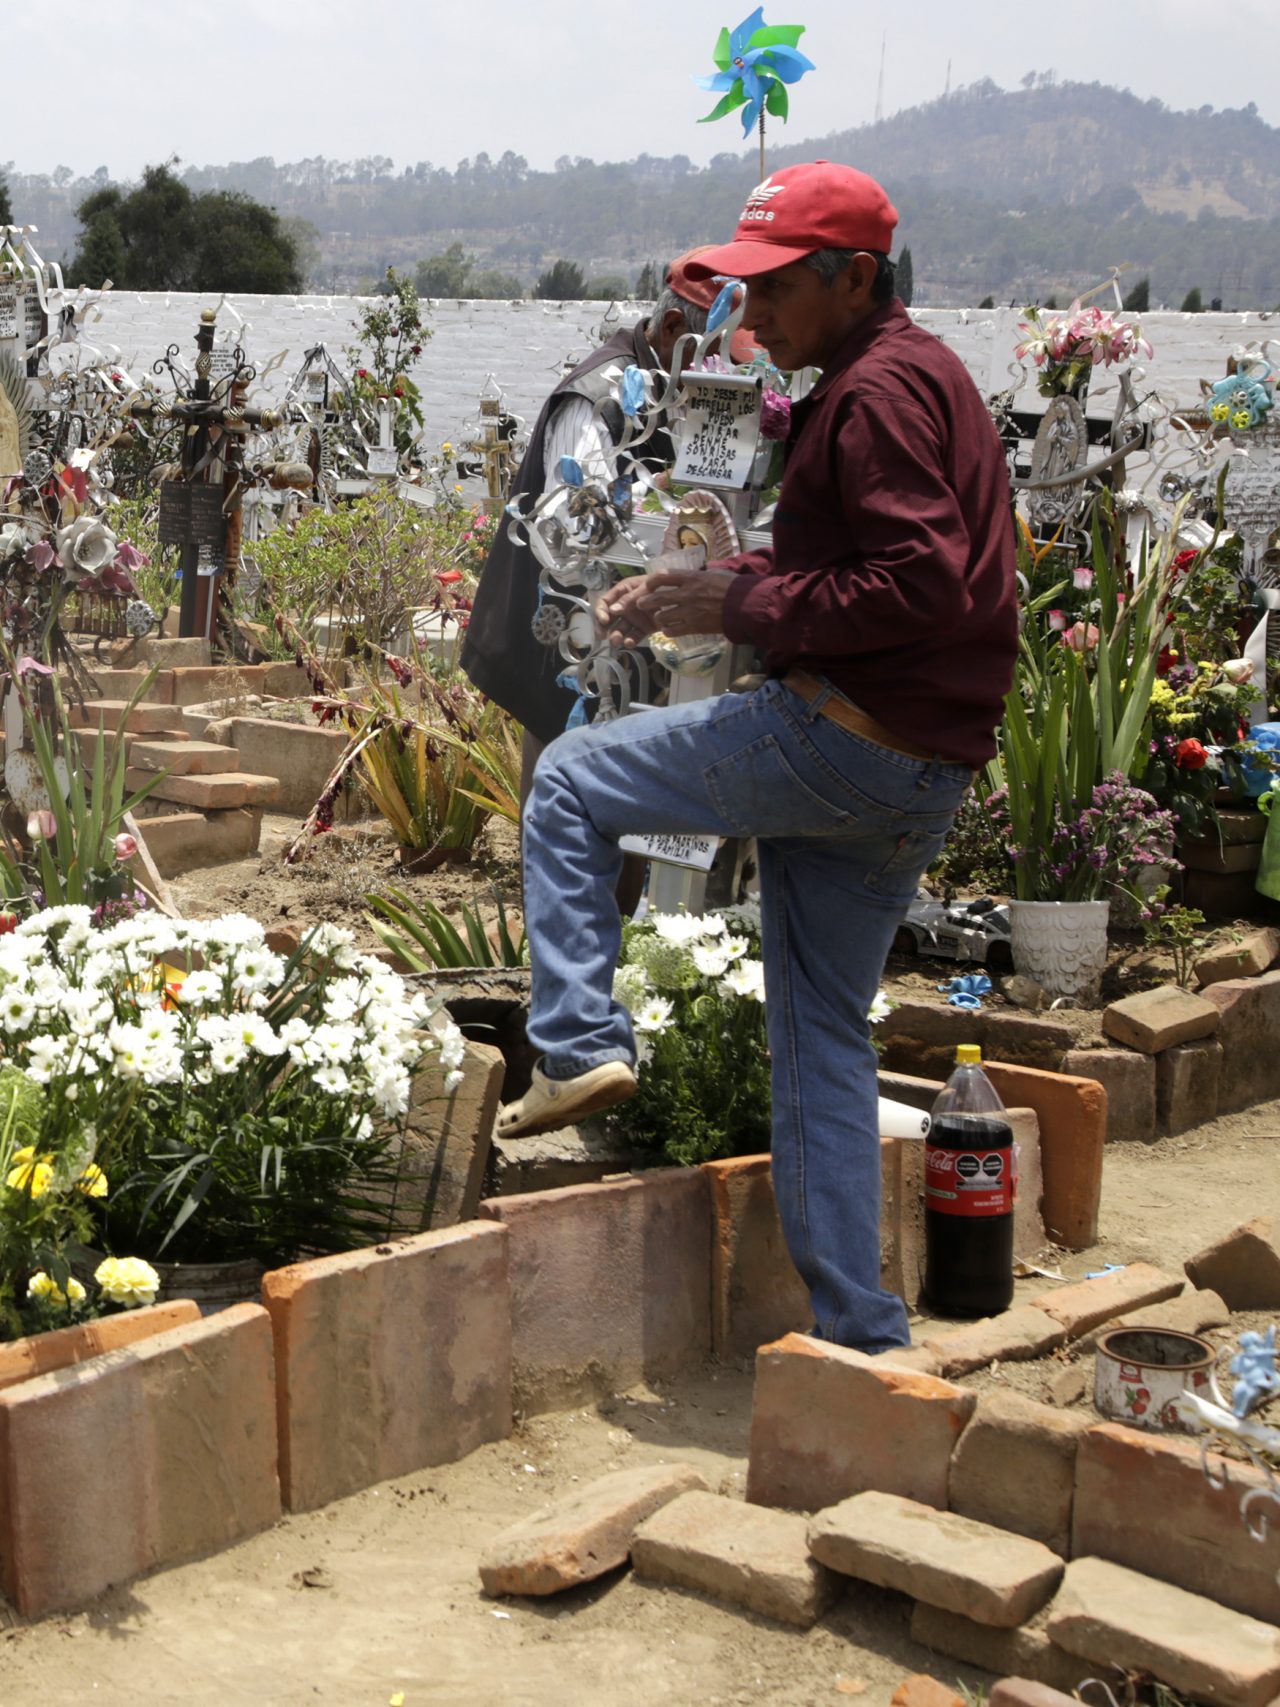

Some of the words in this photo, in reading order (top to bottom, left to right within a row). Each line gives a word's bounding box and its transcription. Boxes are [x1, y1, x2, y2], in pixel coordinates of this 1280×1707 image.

[743, 391, 755, 402] MI
[690, 397, 732, 413] ESTRELLA
[738, 403, 756, 415] LOS
[708, 411, 735, 425] PUEDO
[701, 423, 739, 440] MIRAR
[693, 433, 728, 449] DENME
[686, 443, 737, 461] SONRISAS
[702, 457, 727, 469] PARA
[685, 464, 733, 480] DESCANSAR
